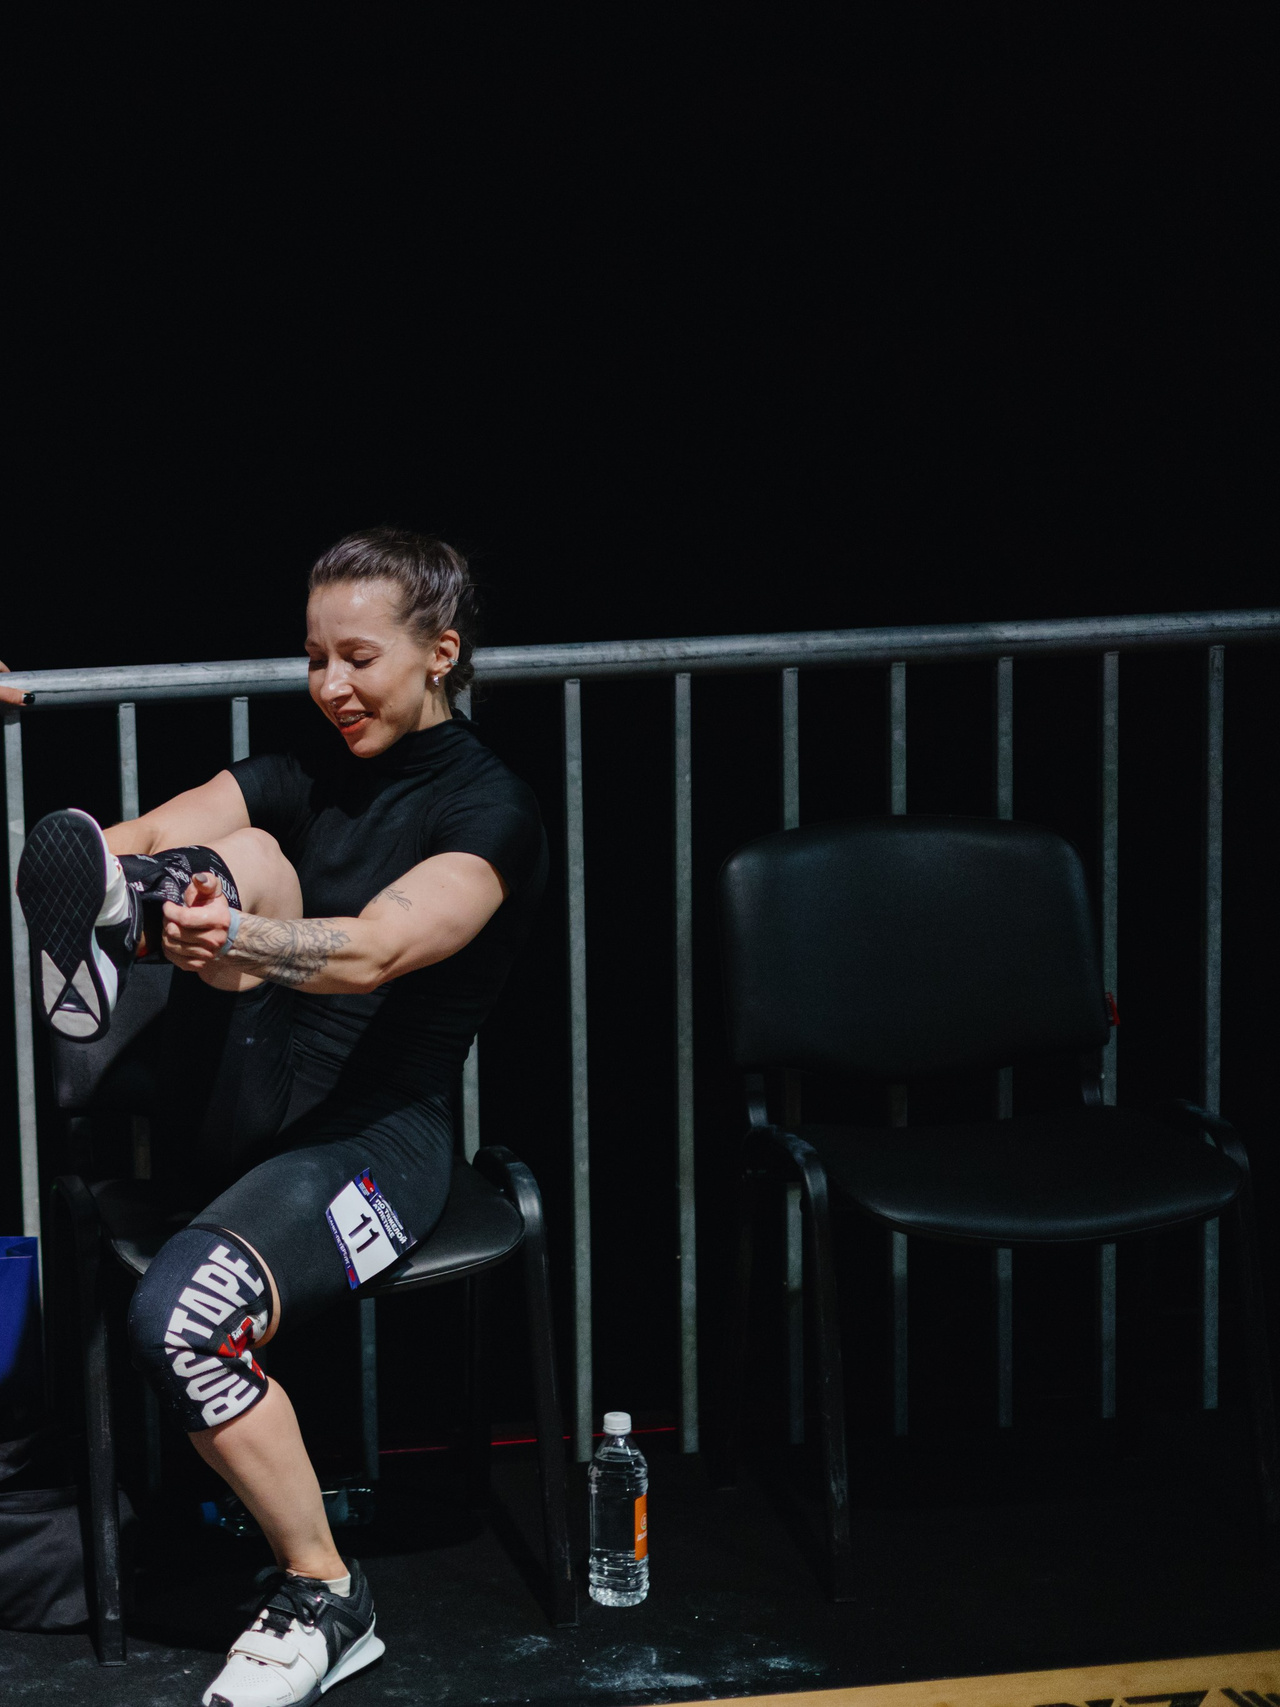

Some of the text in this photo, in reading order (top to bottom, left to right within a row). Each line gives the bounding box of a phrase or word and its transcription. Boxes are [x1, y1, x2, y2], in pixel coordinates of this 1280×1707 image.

[373, 1203, 395, 1239] АТЛЕТИКЕ
[375, 1198, 386, 1210] ПО
[348, 1213, 380, 1254] 11
